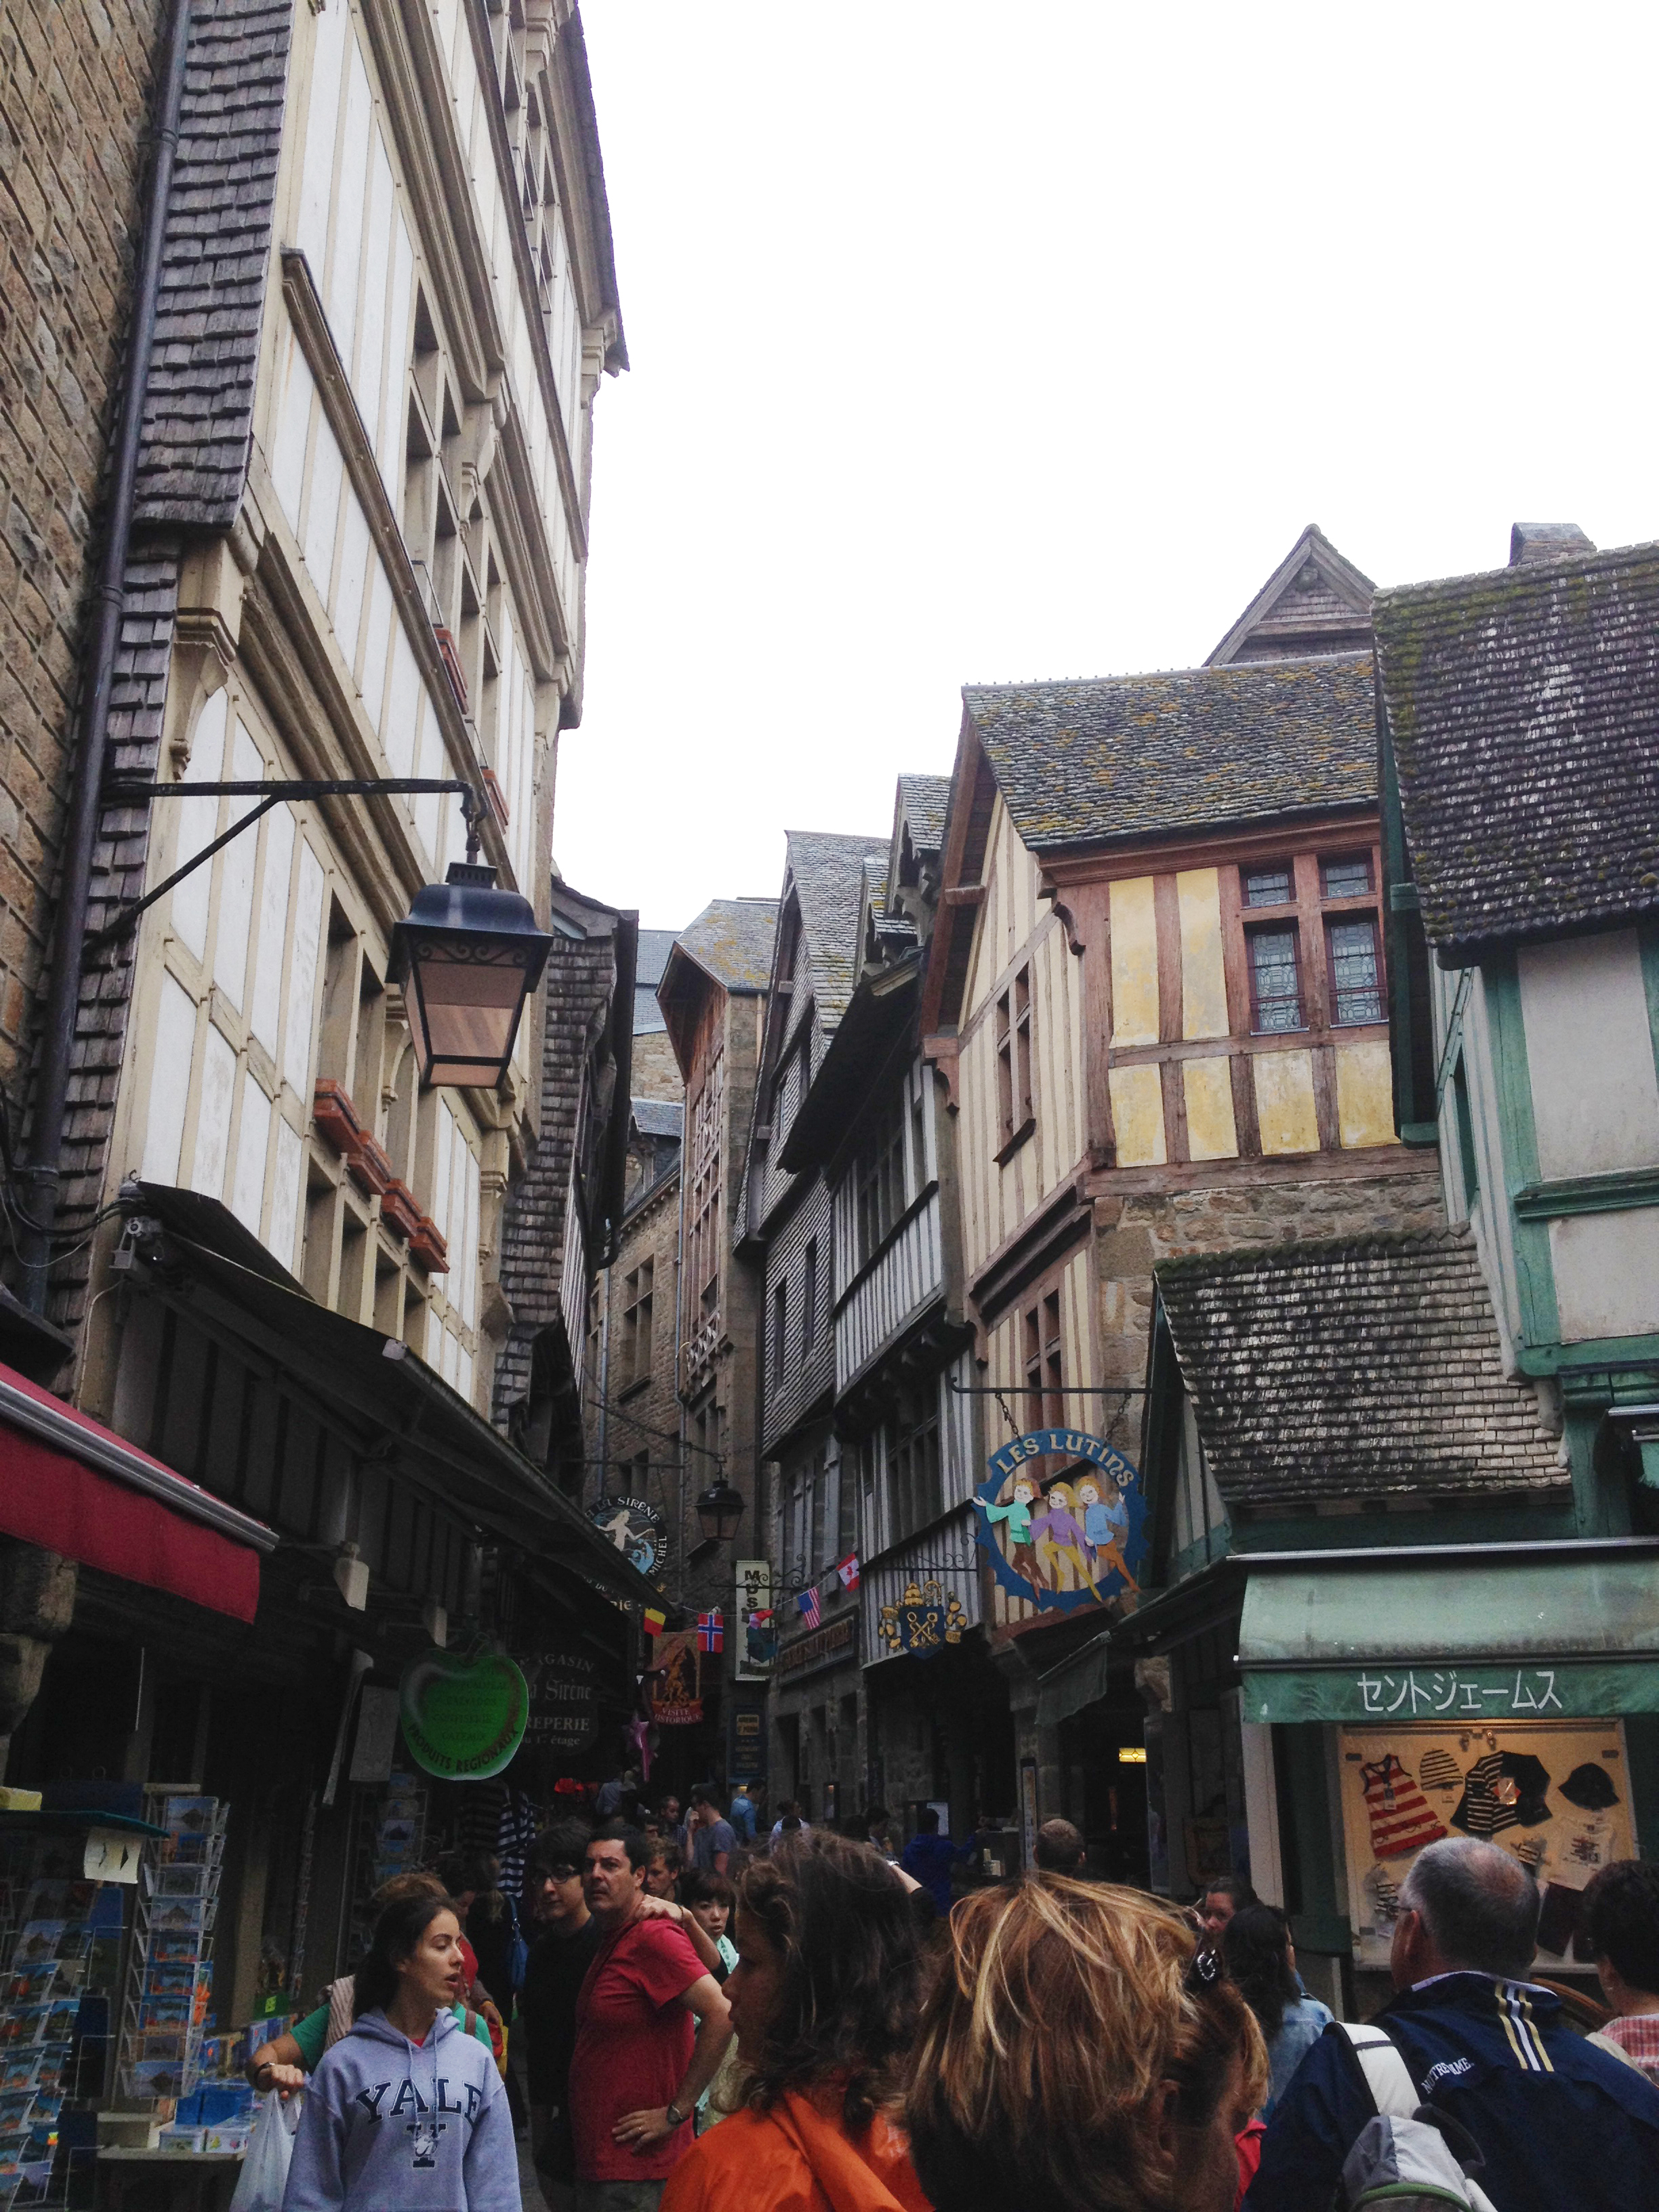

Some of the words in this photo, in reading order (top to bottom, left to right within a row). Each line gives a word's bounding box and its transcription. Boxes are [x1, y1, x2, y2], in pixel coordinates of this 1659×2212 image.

[996, 1437, 1040, 1475] LES
[1050, 1433, 1134, 1487] LUTINS
[649, 1536, 668, 1576] MICHEL
[1357, 1670, 1563, 1714] セントジェームス
[527, 1715, 590, 1731] REPERIE
[407, 1722, 452, 1770] PRODUITS
[1420, 2062, 1450, 2095] NOTRE
[356, 2076, 483, 2126] YALE
